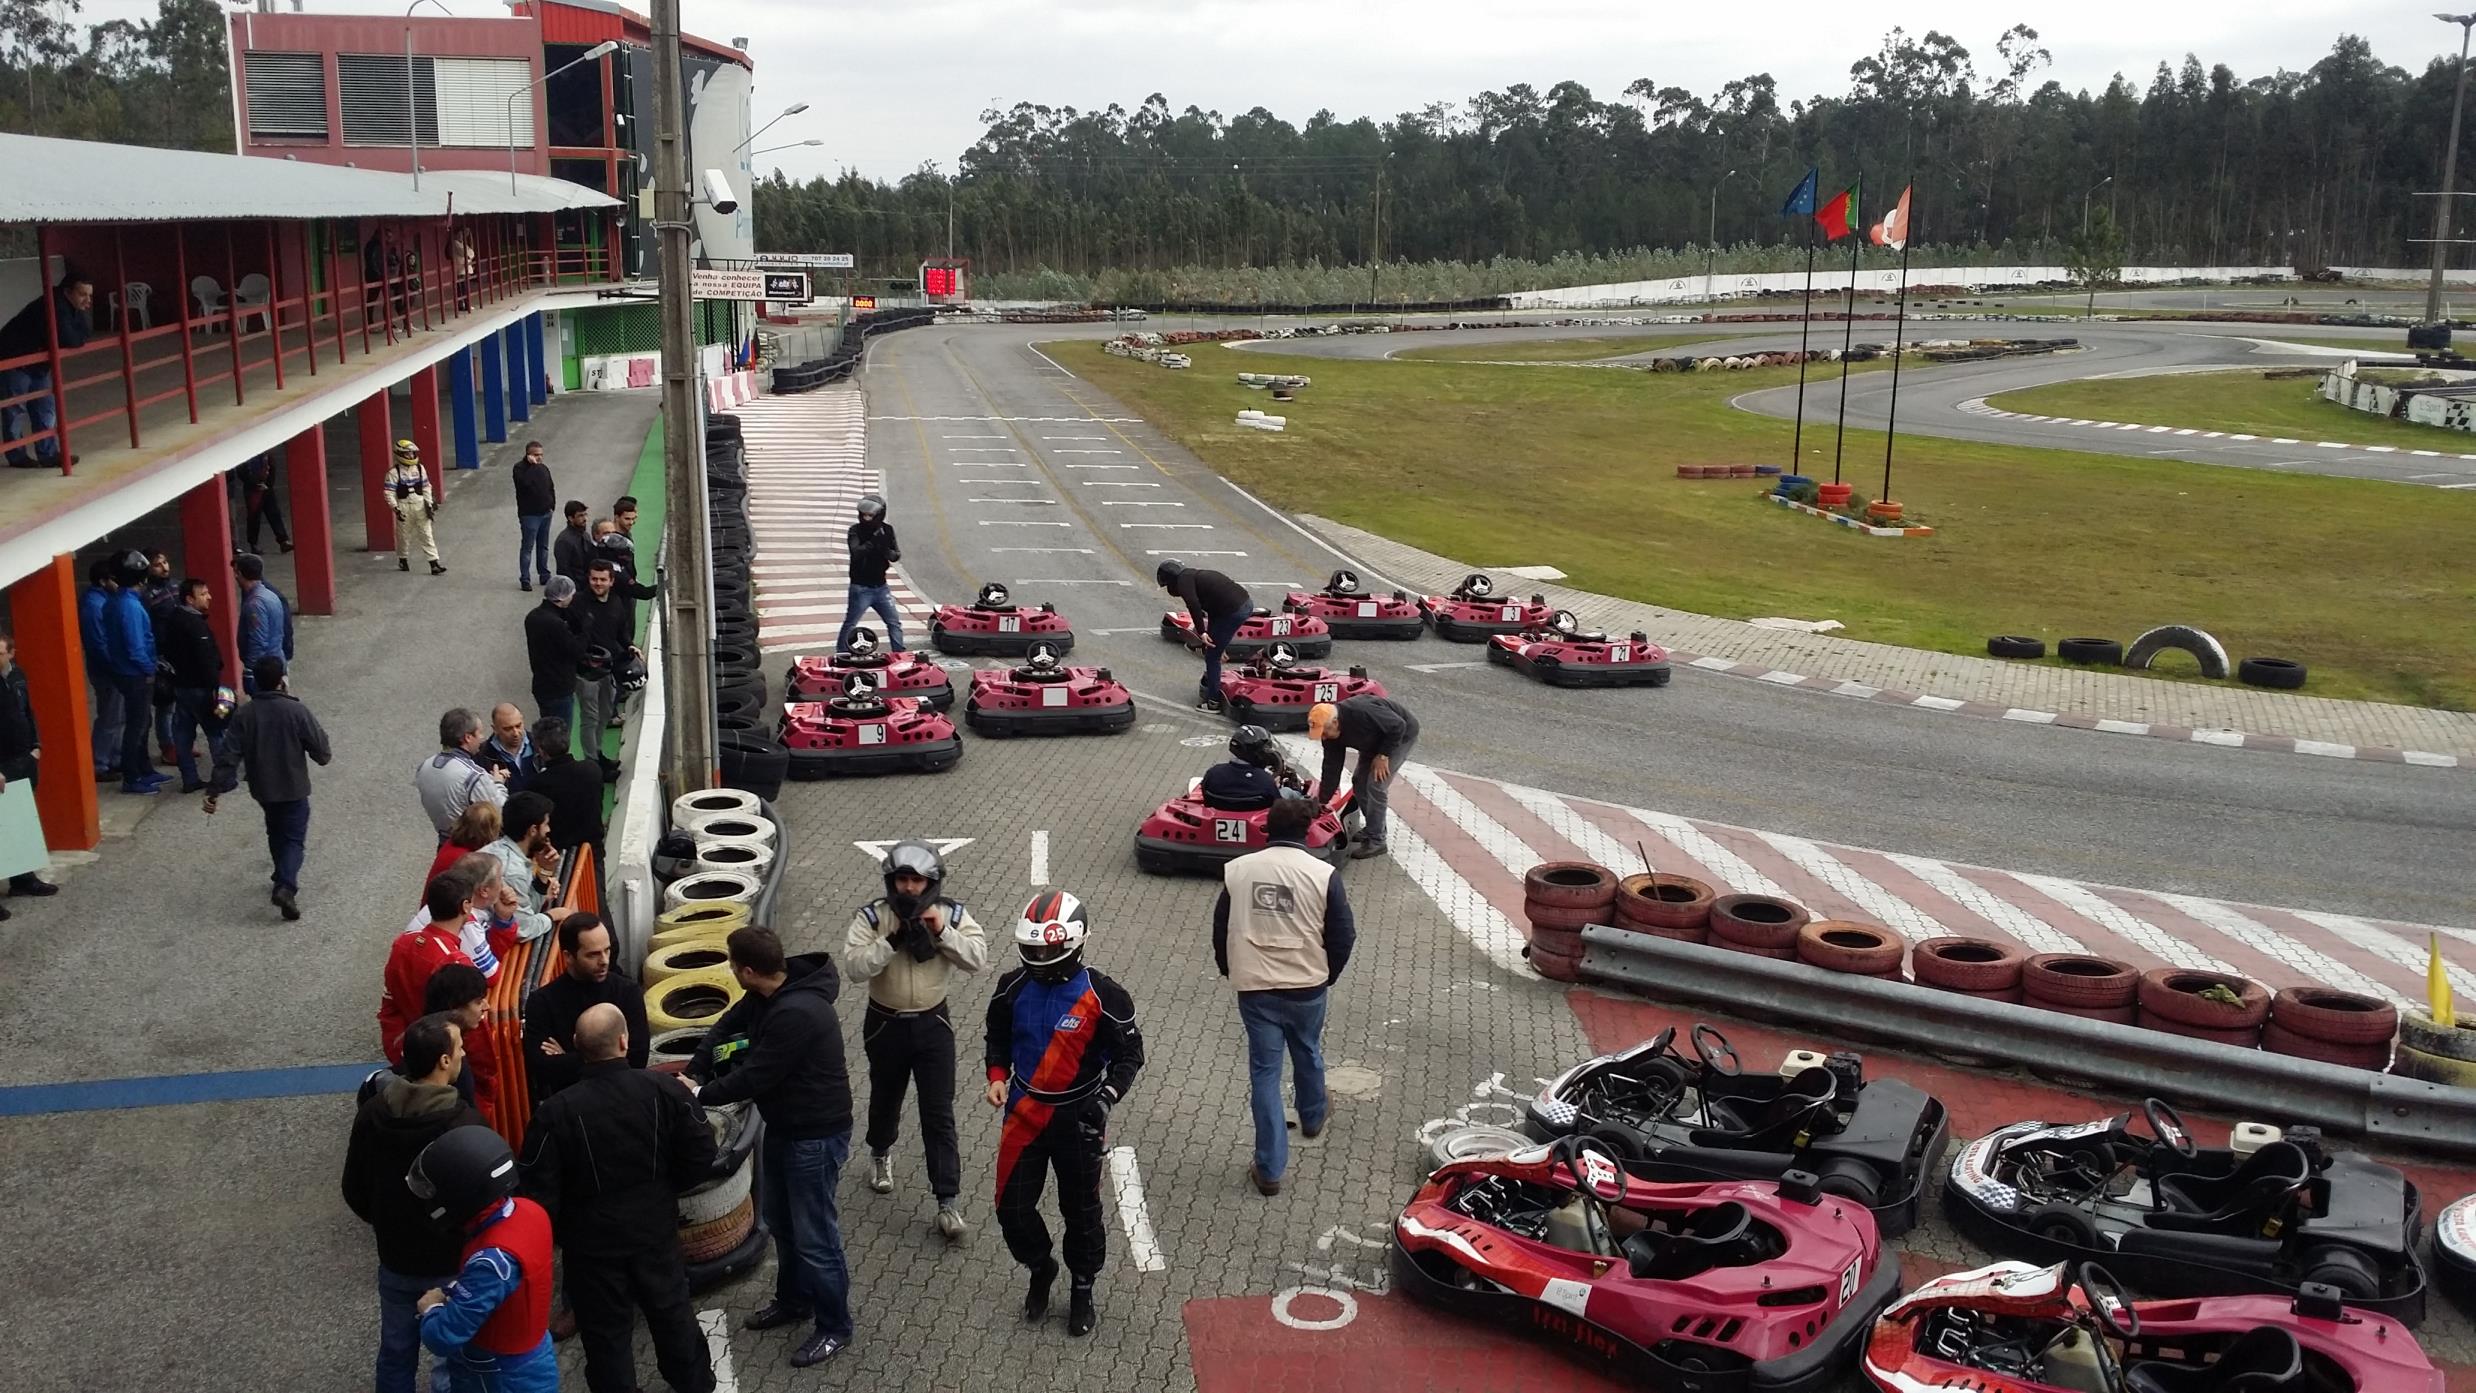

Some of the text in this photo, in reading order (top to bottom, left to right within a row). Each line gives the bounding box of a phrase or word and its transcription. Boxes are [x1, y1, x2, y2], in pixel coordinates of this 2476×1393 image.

[692, 272, 761, 281] Venha conhecer
[706, 289, 762, 297] COMPETIÇÃO
[1005, 616, 1016, 631] 17
[1320, 684, 1333, 702] 25
[876, 724, 884, 743] 9
[1216, 820, 1241, 842] 24
[1046, 927, 1066, 942] 25
[1840, 1261, 1857, 1305] 20
